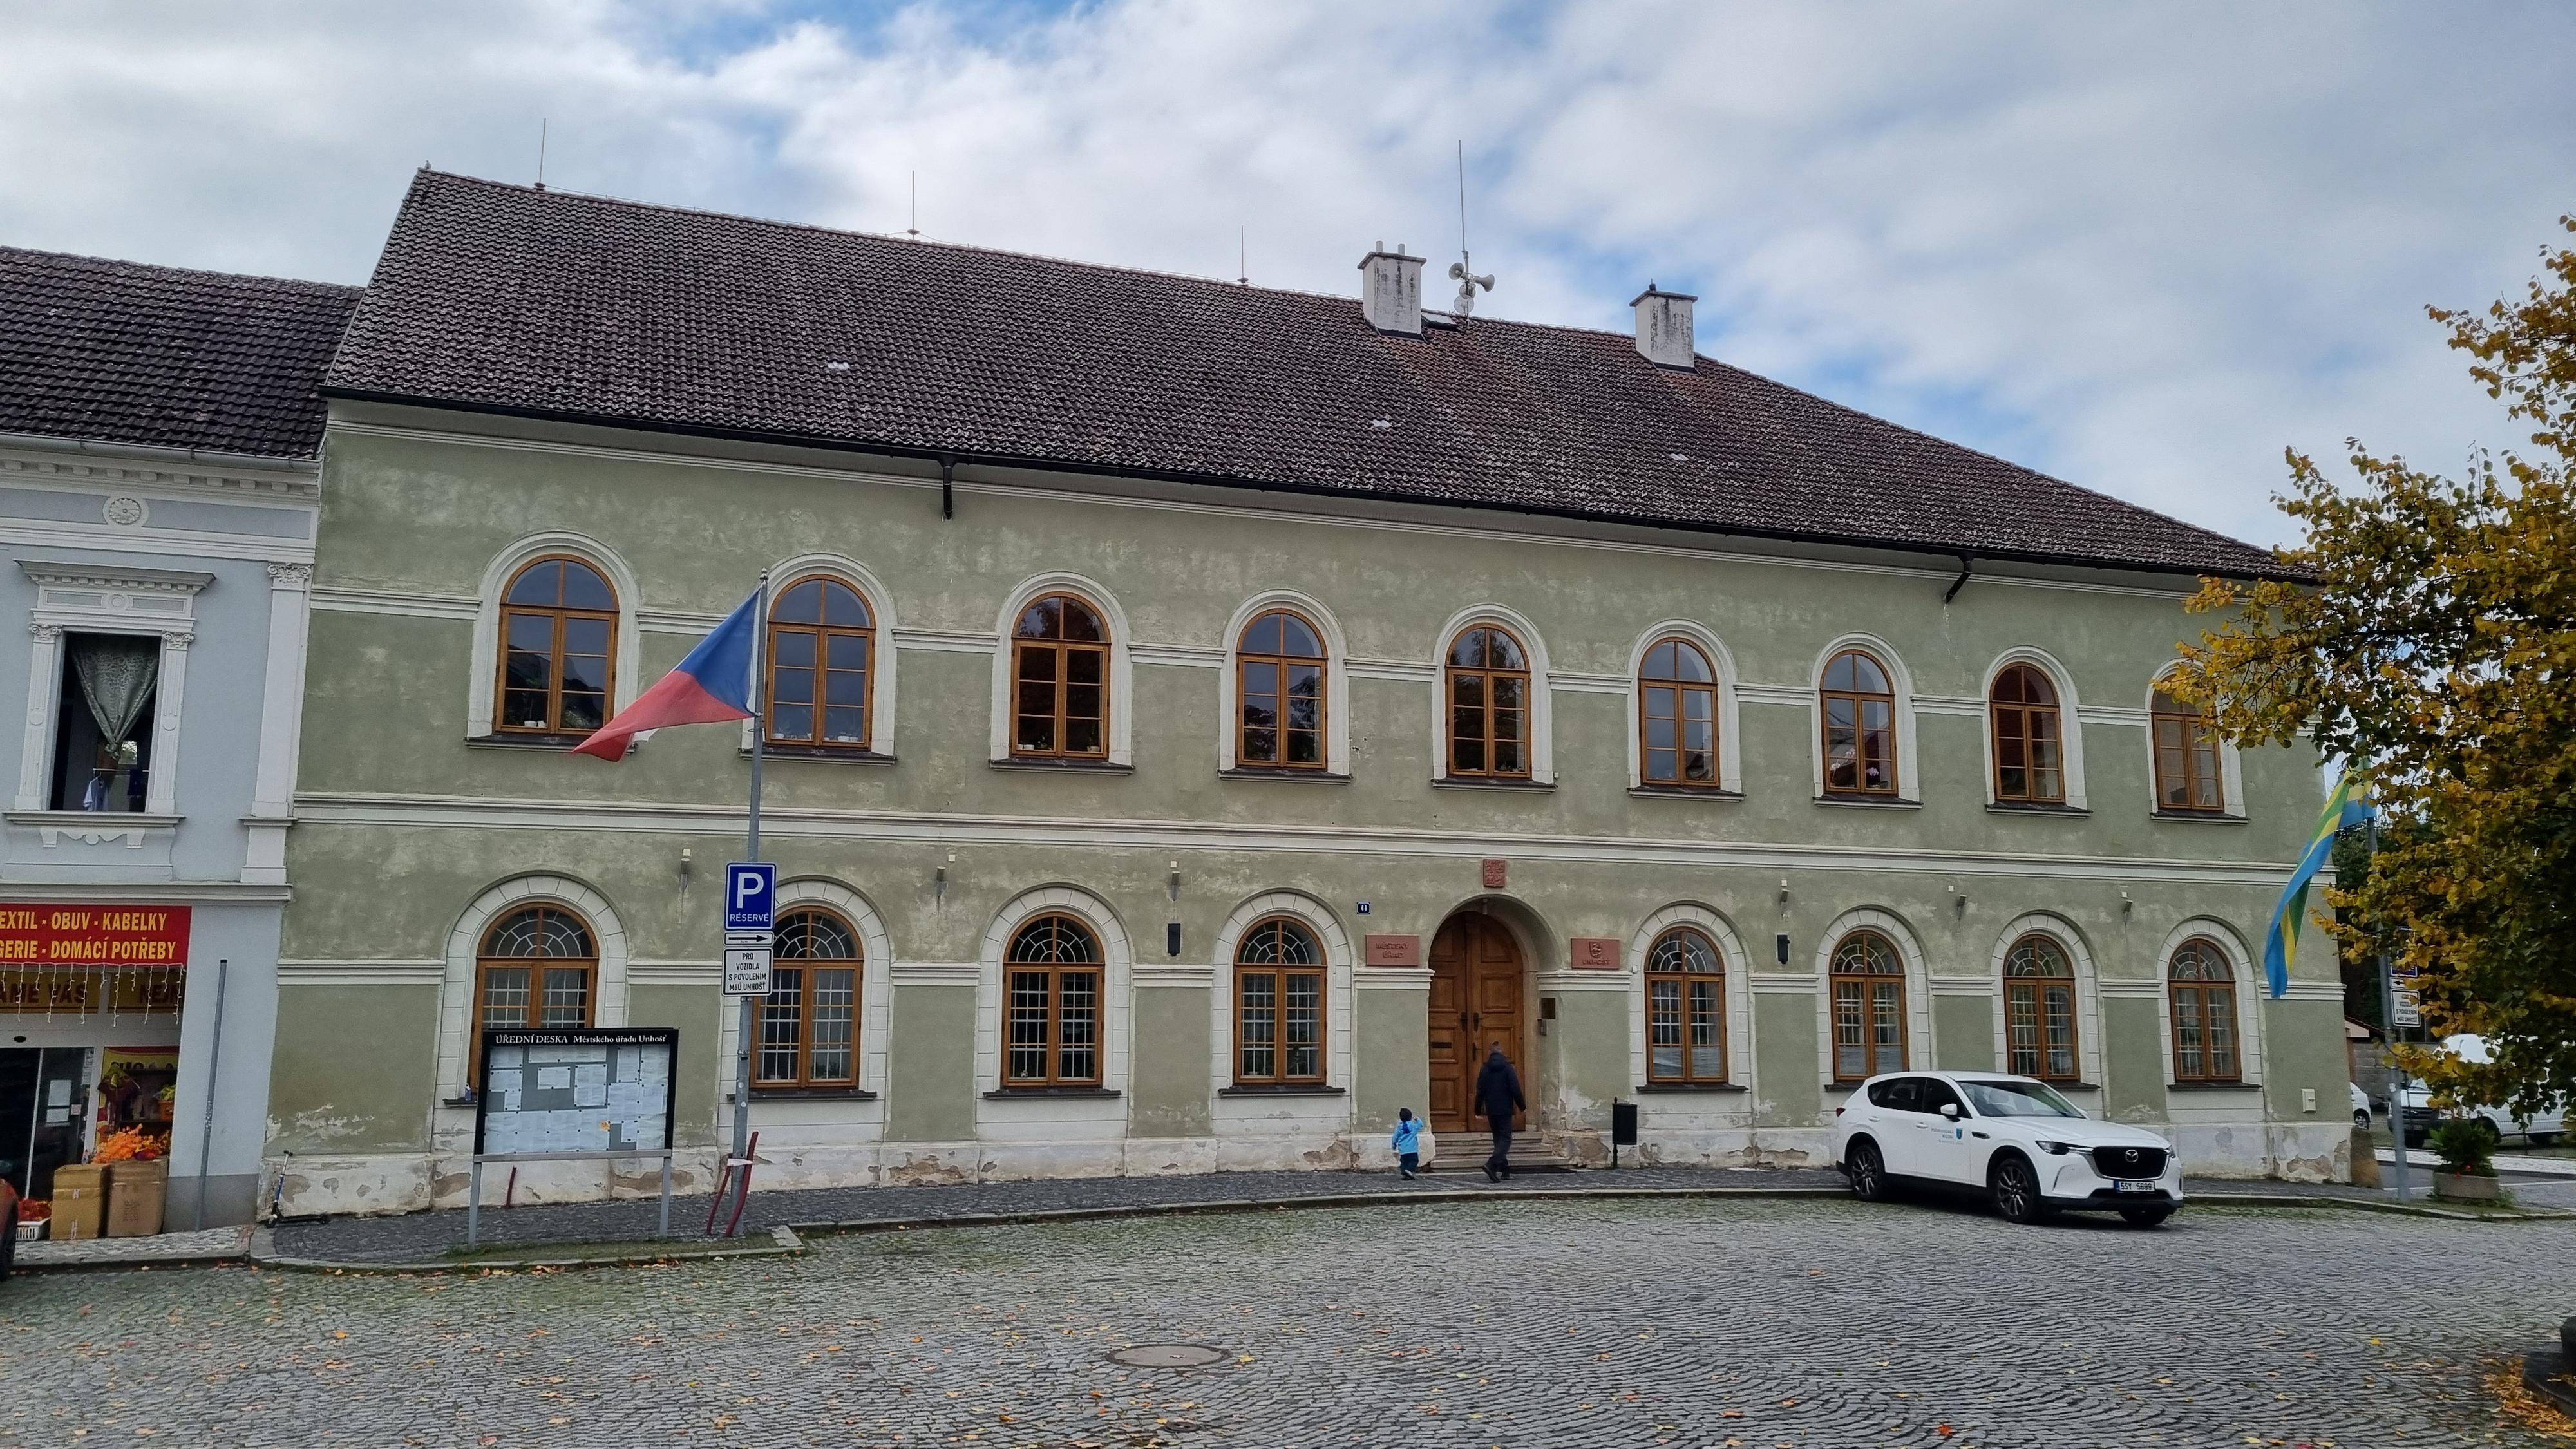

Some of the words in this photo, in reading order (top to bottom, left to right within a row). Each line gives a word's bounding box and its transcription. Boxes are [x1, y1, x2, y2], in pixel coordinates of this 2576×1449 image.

[736, 872, 764, 909] P
[51, 912, 91, 931] OBUV
[102, 913, 167, 931] KABELKY
[730, 912, 770, 922] RÉSERVÉ
[50, 936, 109, 959] DOMÁCÍ
[111, 936, 176, 960] POTŘEBY
[734, 971, 766, 980] POVOLENÍM
[743, 981, 766, 990] UNHOŠŤ
[495, 1034, 535, 1044] ÚŘEDNÍ
[536, 1035, 568, 1043] DESKA
[573, 1035, 614, 1043] Městského
[638, 1034, 667, 1043] Unhošť
